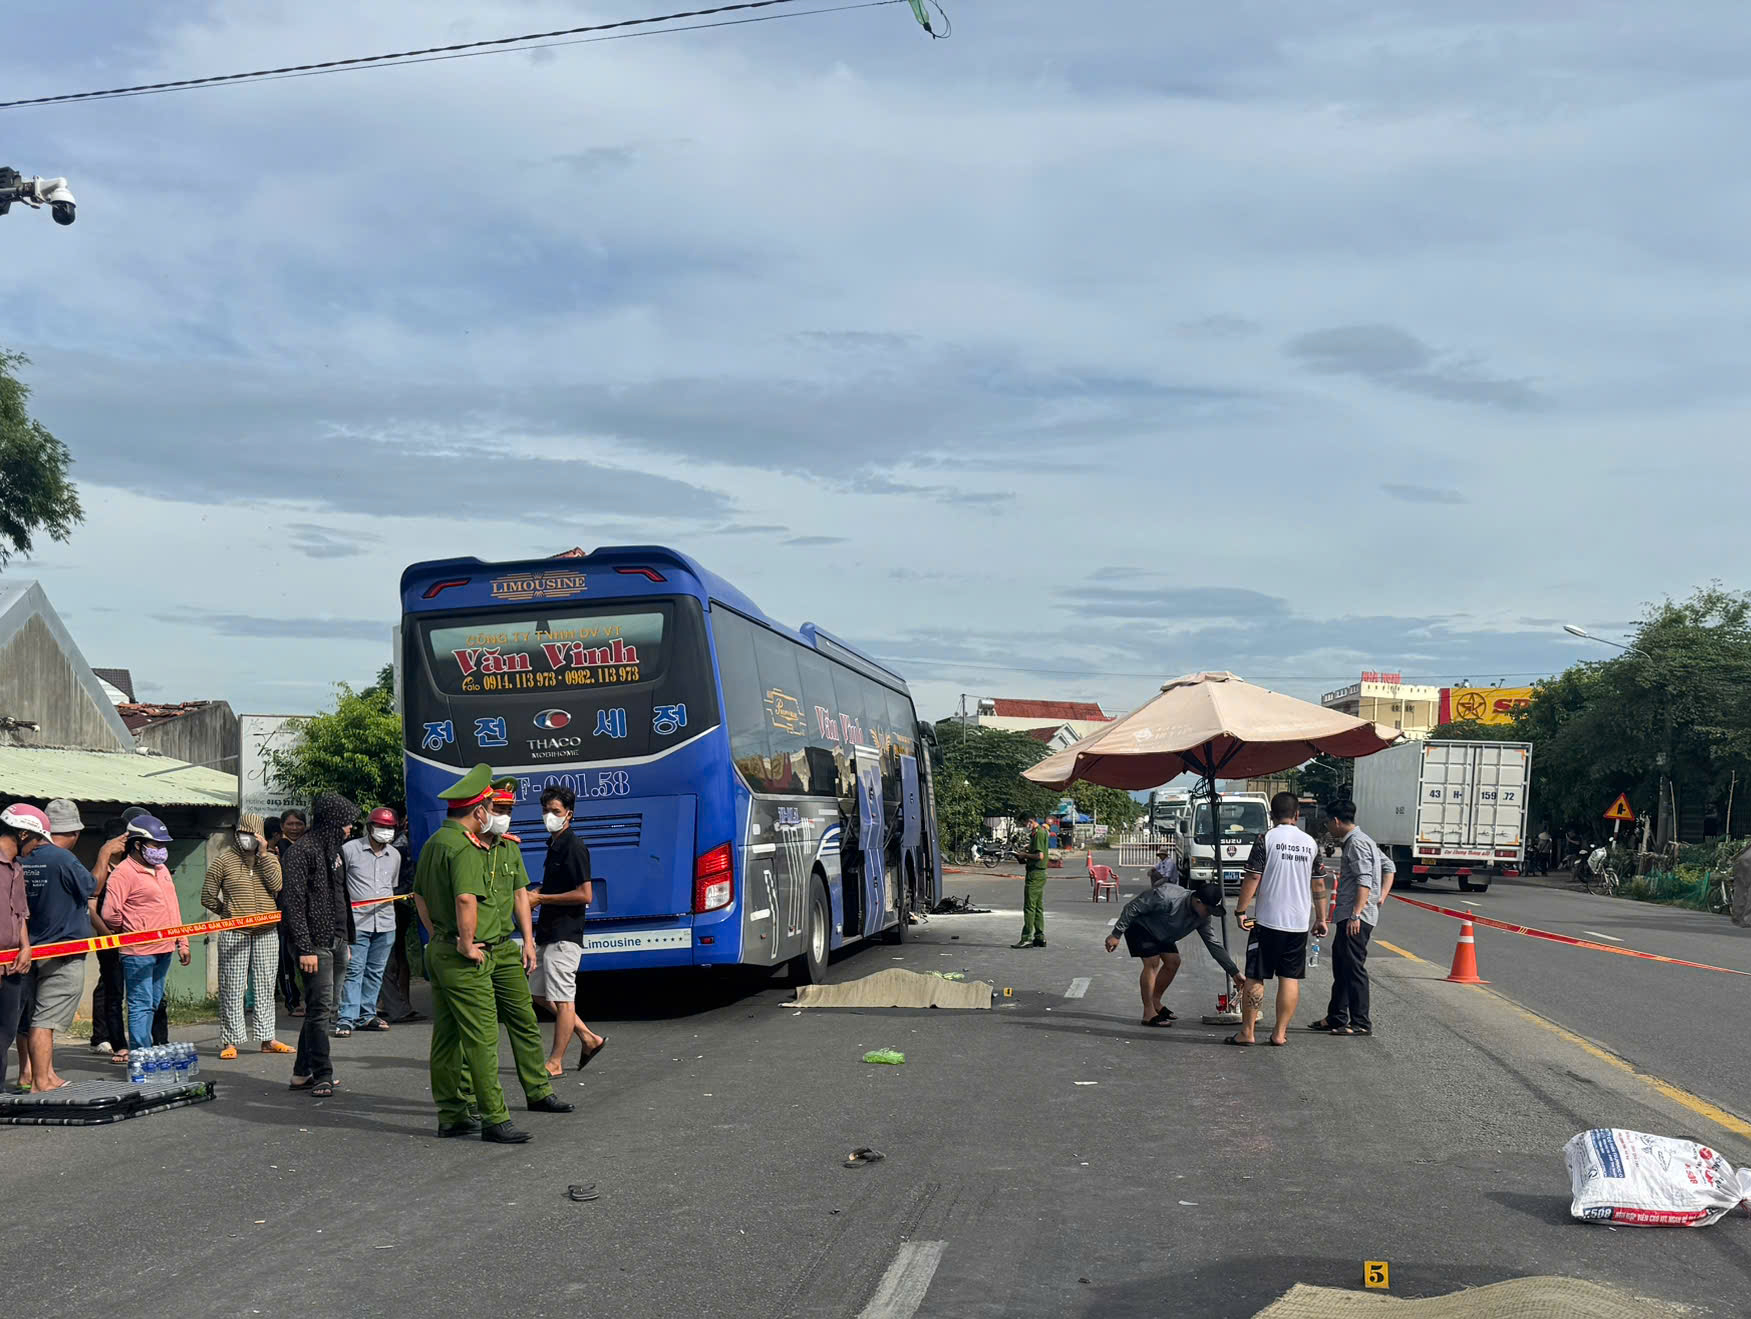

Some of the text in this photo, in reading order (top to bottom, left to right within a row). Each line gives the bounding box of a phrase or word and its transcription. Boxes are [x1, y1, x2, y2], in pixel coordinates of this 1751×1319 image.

[493, 576, 586, 593] LIMOUSINE
[466, 625, 622, 647] CÔNG TY TNHH DV VT
[453, 637, 640, 676] Văn Vinh
[515, 672, 535, 688] 113
[537, 671, 557, 686] 973
[597, 667, 617, 683] 113
[619, 666, 640, 681] 973
[422, 703, 687, 751] 정 전 세 정
[526, 737, 582, 751] THACO
[531, 749, 579, 759] MOBIHOME
[513, 770, 630, 801] F-001.58
[1429, 790, 1441, 798] 43
[1481, 791, 1497, 800] 159
[1369, 1264, 1385, 1284] 5
